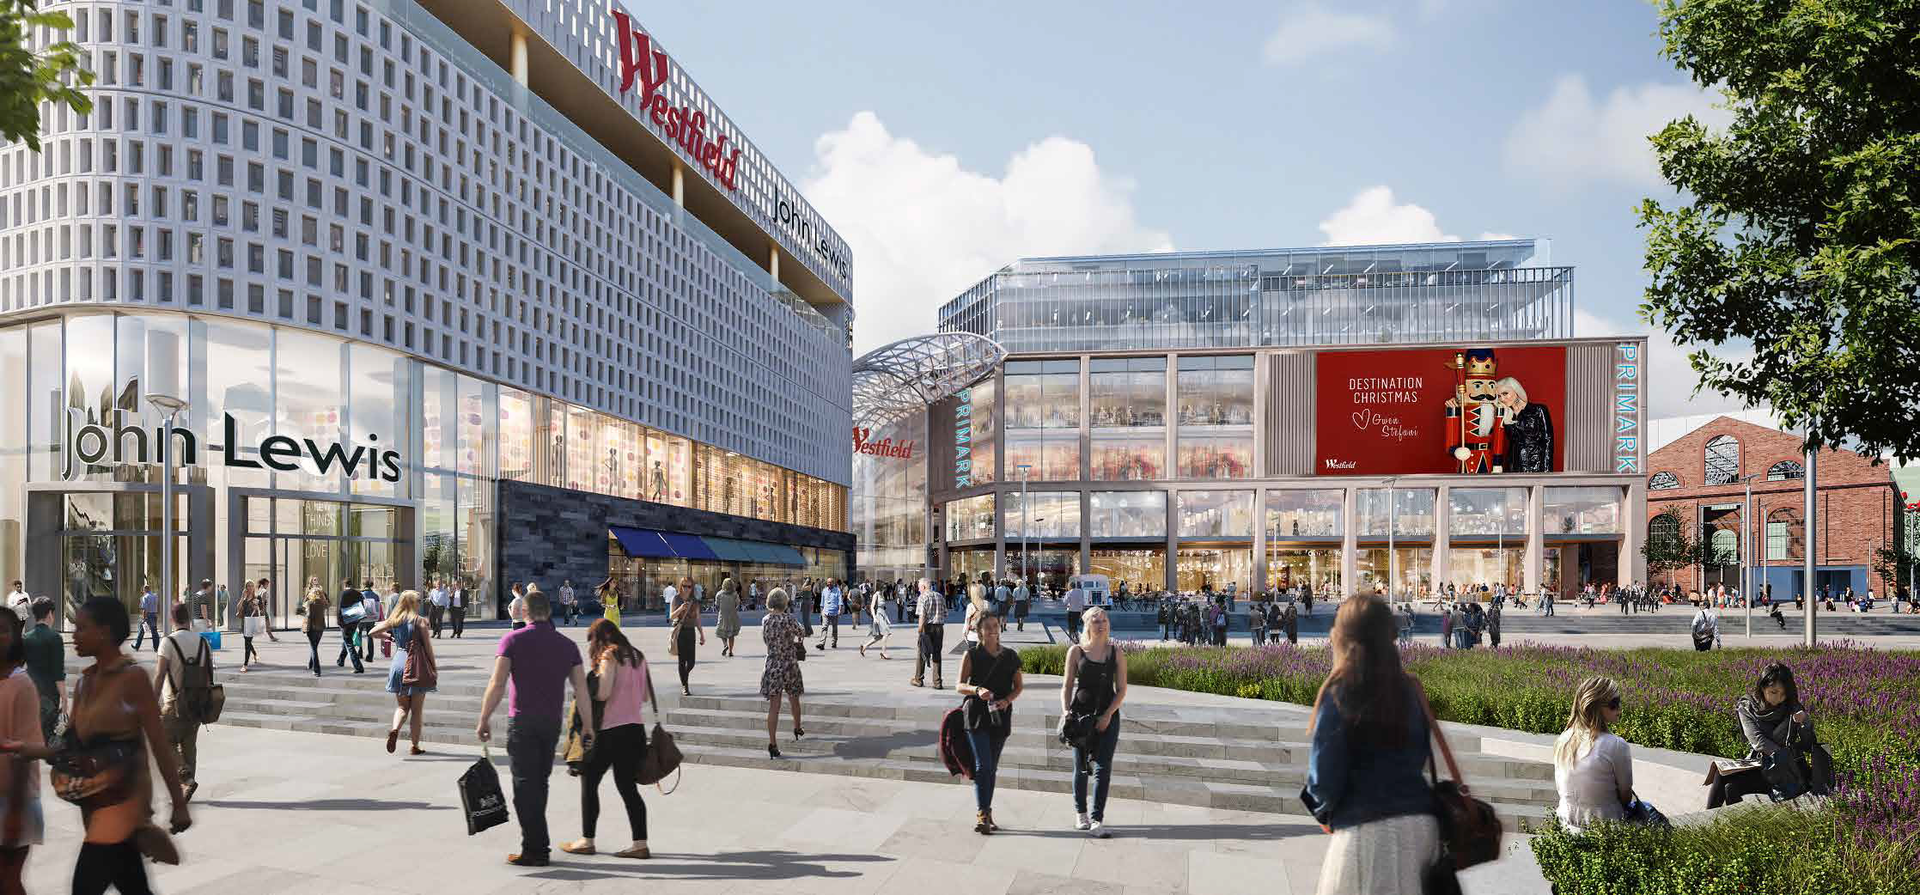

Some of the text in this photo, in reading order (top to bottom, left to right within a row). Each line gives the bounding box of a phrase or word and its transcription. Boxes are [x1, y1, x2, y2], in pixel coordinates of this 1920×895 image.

[611, 9, 742, 192] Westfield
[772, 183, 847, 279] John Lewis
[1349, 377, 1423, 390] DESTINATION
[1353, 391, 1418, 404] CHRISTMAS
[1616, 343, 1637, 473] PRIMARK
[1372, 413, 1400, 425] Gwen
[955, 387, 971, 489] PRIMARK
[1381, 425, 1418, 442] Stefani
[61, 407, 402, 483] John Lewis
[1325, 459, 1357, 469] Westfield
[305, 513, 337, 527] THINGS
[305, 544, 328, 558] LOVE
